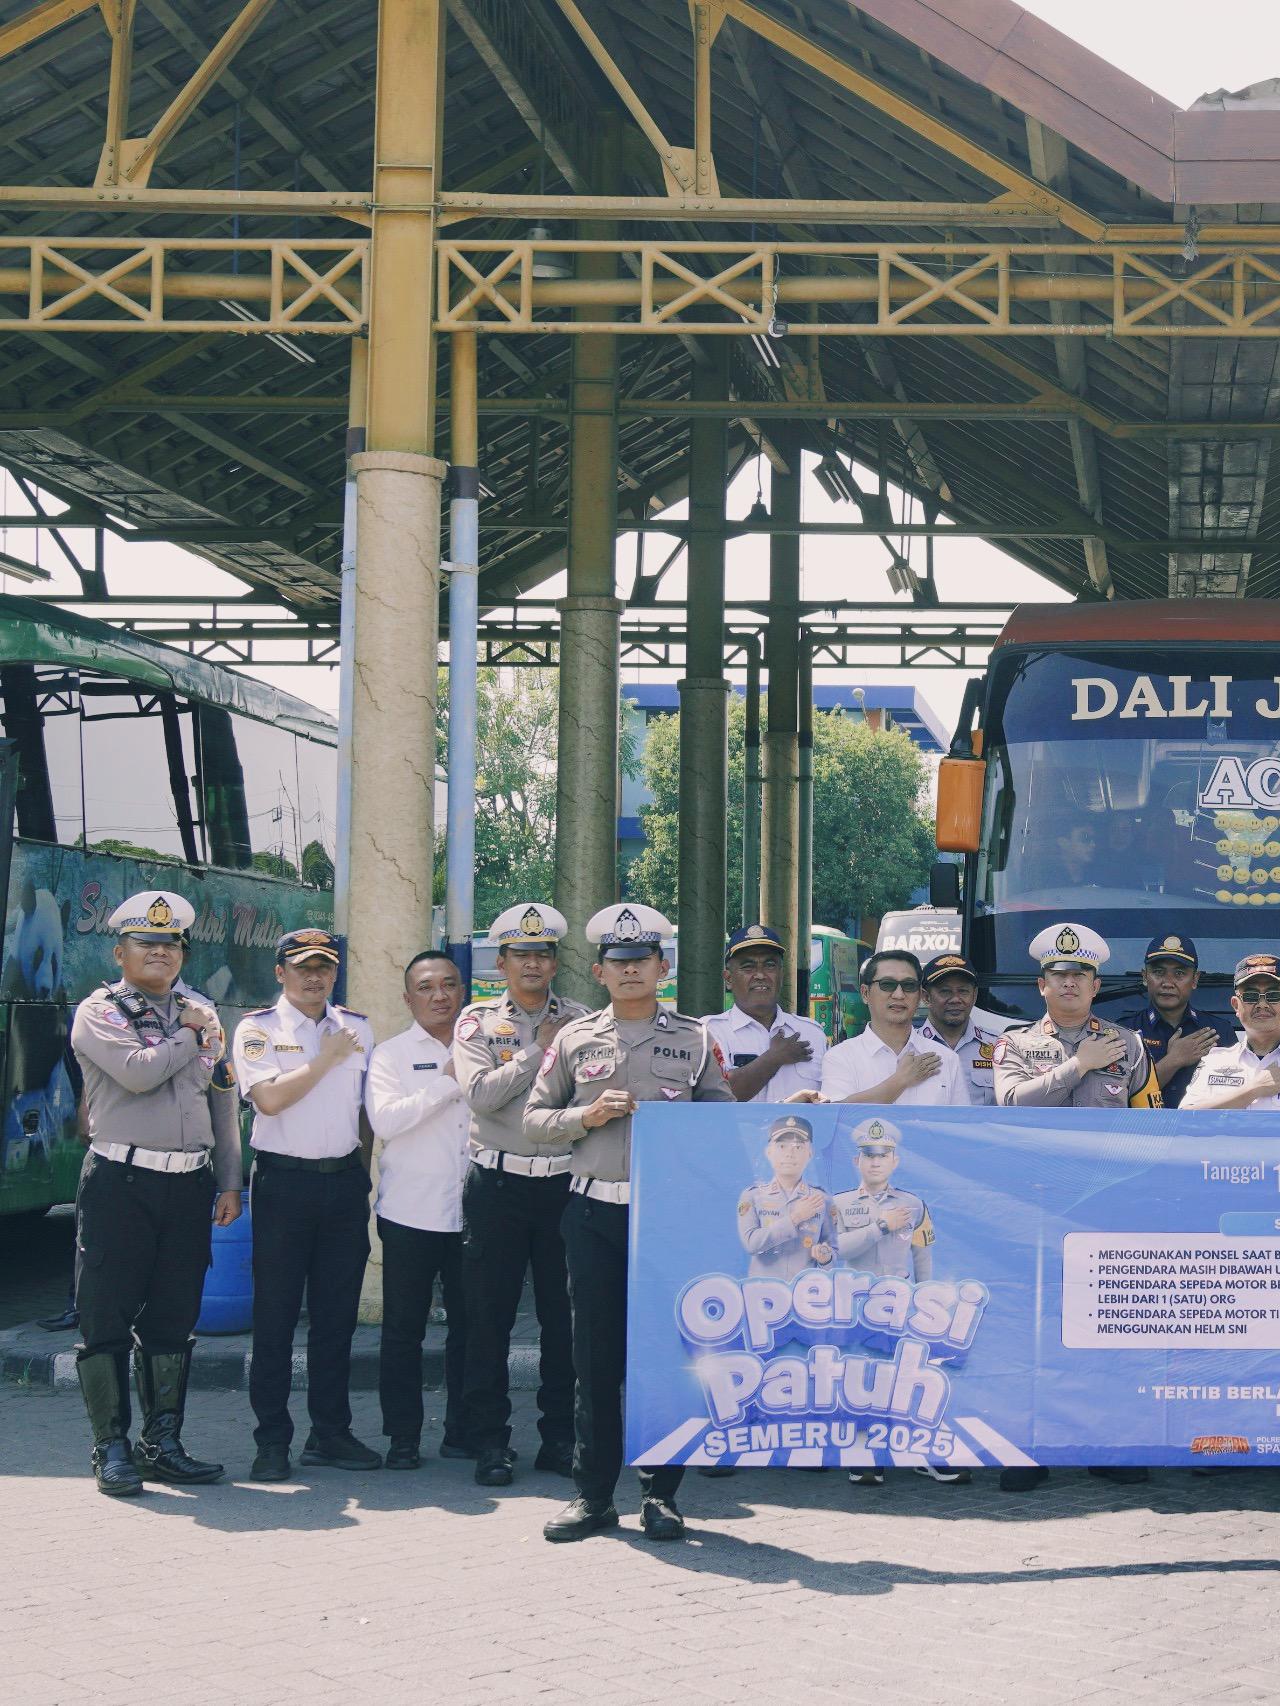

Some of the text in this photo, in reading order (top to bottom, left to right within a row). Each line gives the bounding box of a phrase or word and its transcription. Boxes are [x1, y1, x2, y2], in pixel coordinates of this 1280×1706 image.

[1072, 675, 1233, 721] DALI
[653, 1046, 691, 1061] POLRI
[1200, 1160, 1265, 1184] Tanggal
[1098, 1250, 1192, 1260] MENGGUNAKAN
[1194, 1250, 1239, 1260] PONSEL
[1242, 1250, 1272, 1260] SAAT
[1098, 1265, 1177, 1275] PENGENDARA
[1179, 1265, 1216, 1275] MASIH
[1219, 1265, 1272, 1275] DIBAWAH
[1098, 1279, 1177, 1290] PENGENDARA
[1179, 1279, 1223, 1290] SEPEDA
[1225, 1279, 1267, 1290] MOTOR
[1098, 1295, 1236, 1306] LEBIH DARI 1 (SATU) ORG
[677, 1269, 989, 1349] Operasi
[1097, 1309, 1176, 1320] PENGENDARA
[1179, 1309, 1222, 1320] SEPEDA
[1225, 1309, 1267, 1320] MOTOR
[1097, 1324, 1247, 1334] MENGGUNAKAN HELM SNI
[703, 1338, 949, 1428] Patuh
[1152, 1386, 1221, 1399] TERTIB
[704, 1422, 956, 1458] SEMERU 2025
